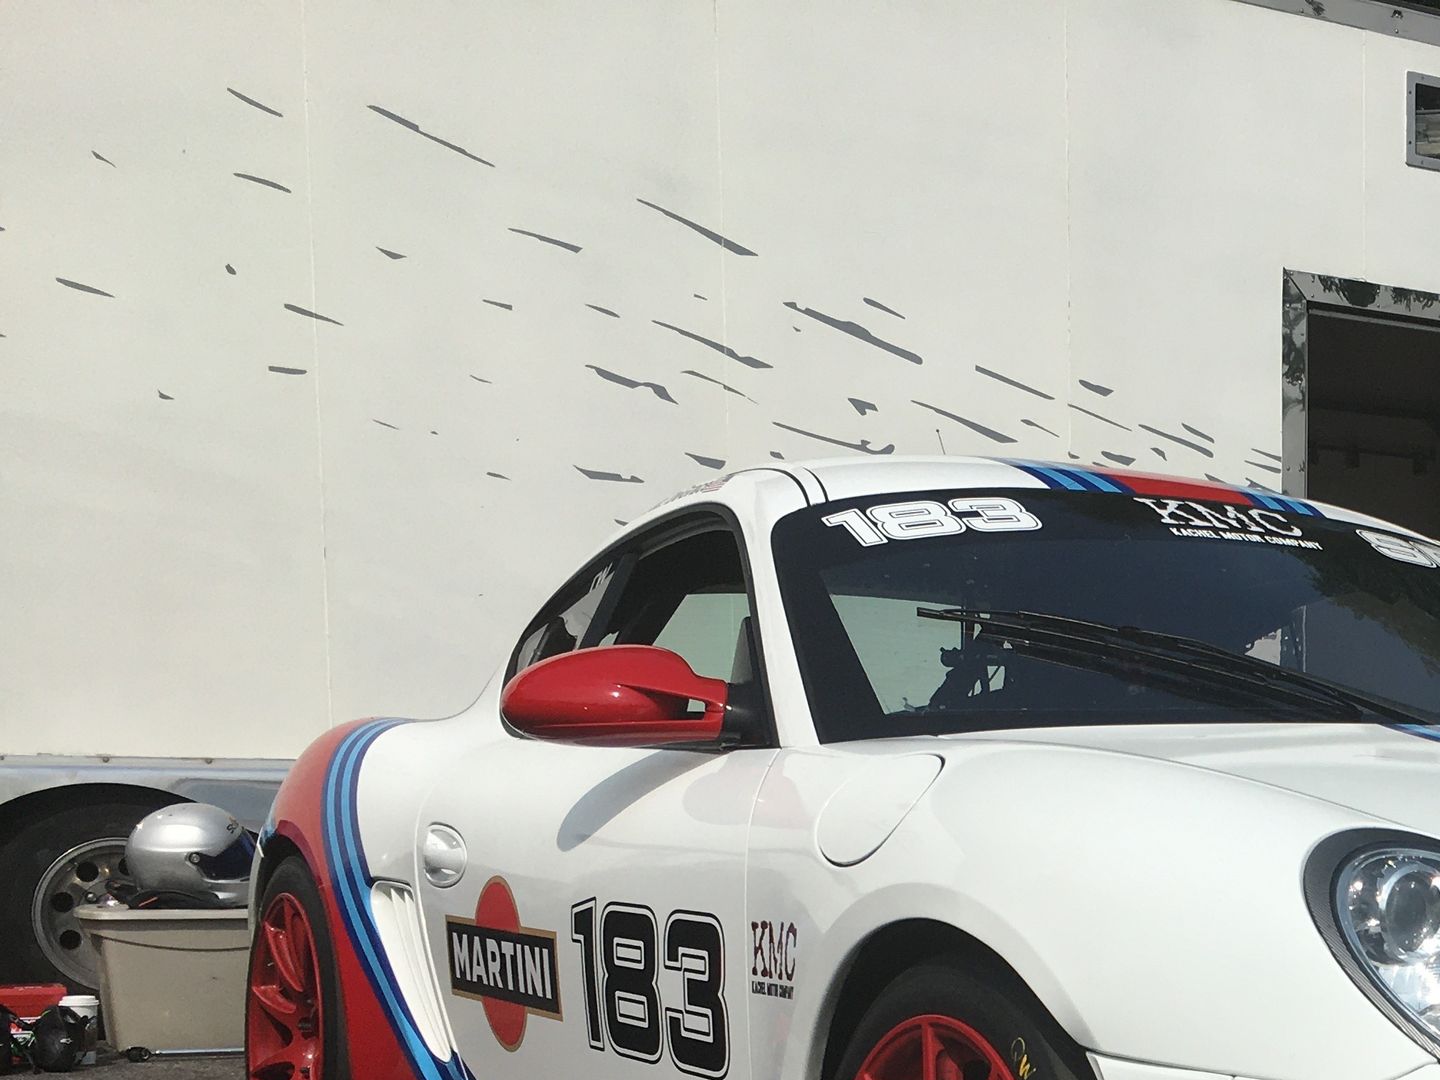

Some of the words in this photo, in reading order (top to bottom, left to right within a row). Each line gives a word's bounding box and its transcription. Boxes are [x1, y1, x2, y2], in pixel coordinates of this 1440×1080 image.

[821, 497, 1043, 547] 183
[1133, 497, 1303, 537] KMC
[1169, 527, 1221, 539] KACHEL
[1218, 531, 1264, 543] MOTOR
[1265, 535, 1324, 551] COMPANY
[452, 931, 552, 999] MARTINI
[751, 920, 797, 982] KMC
[571, 896, 731, 1080] 183
